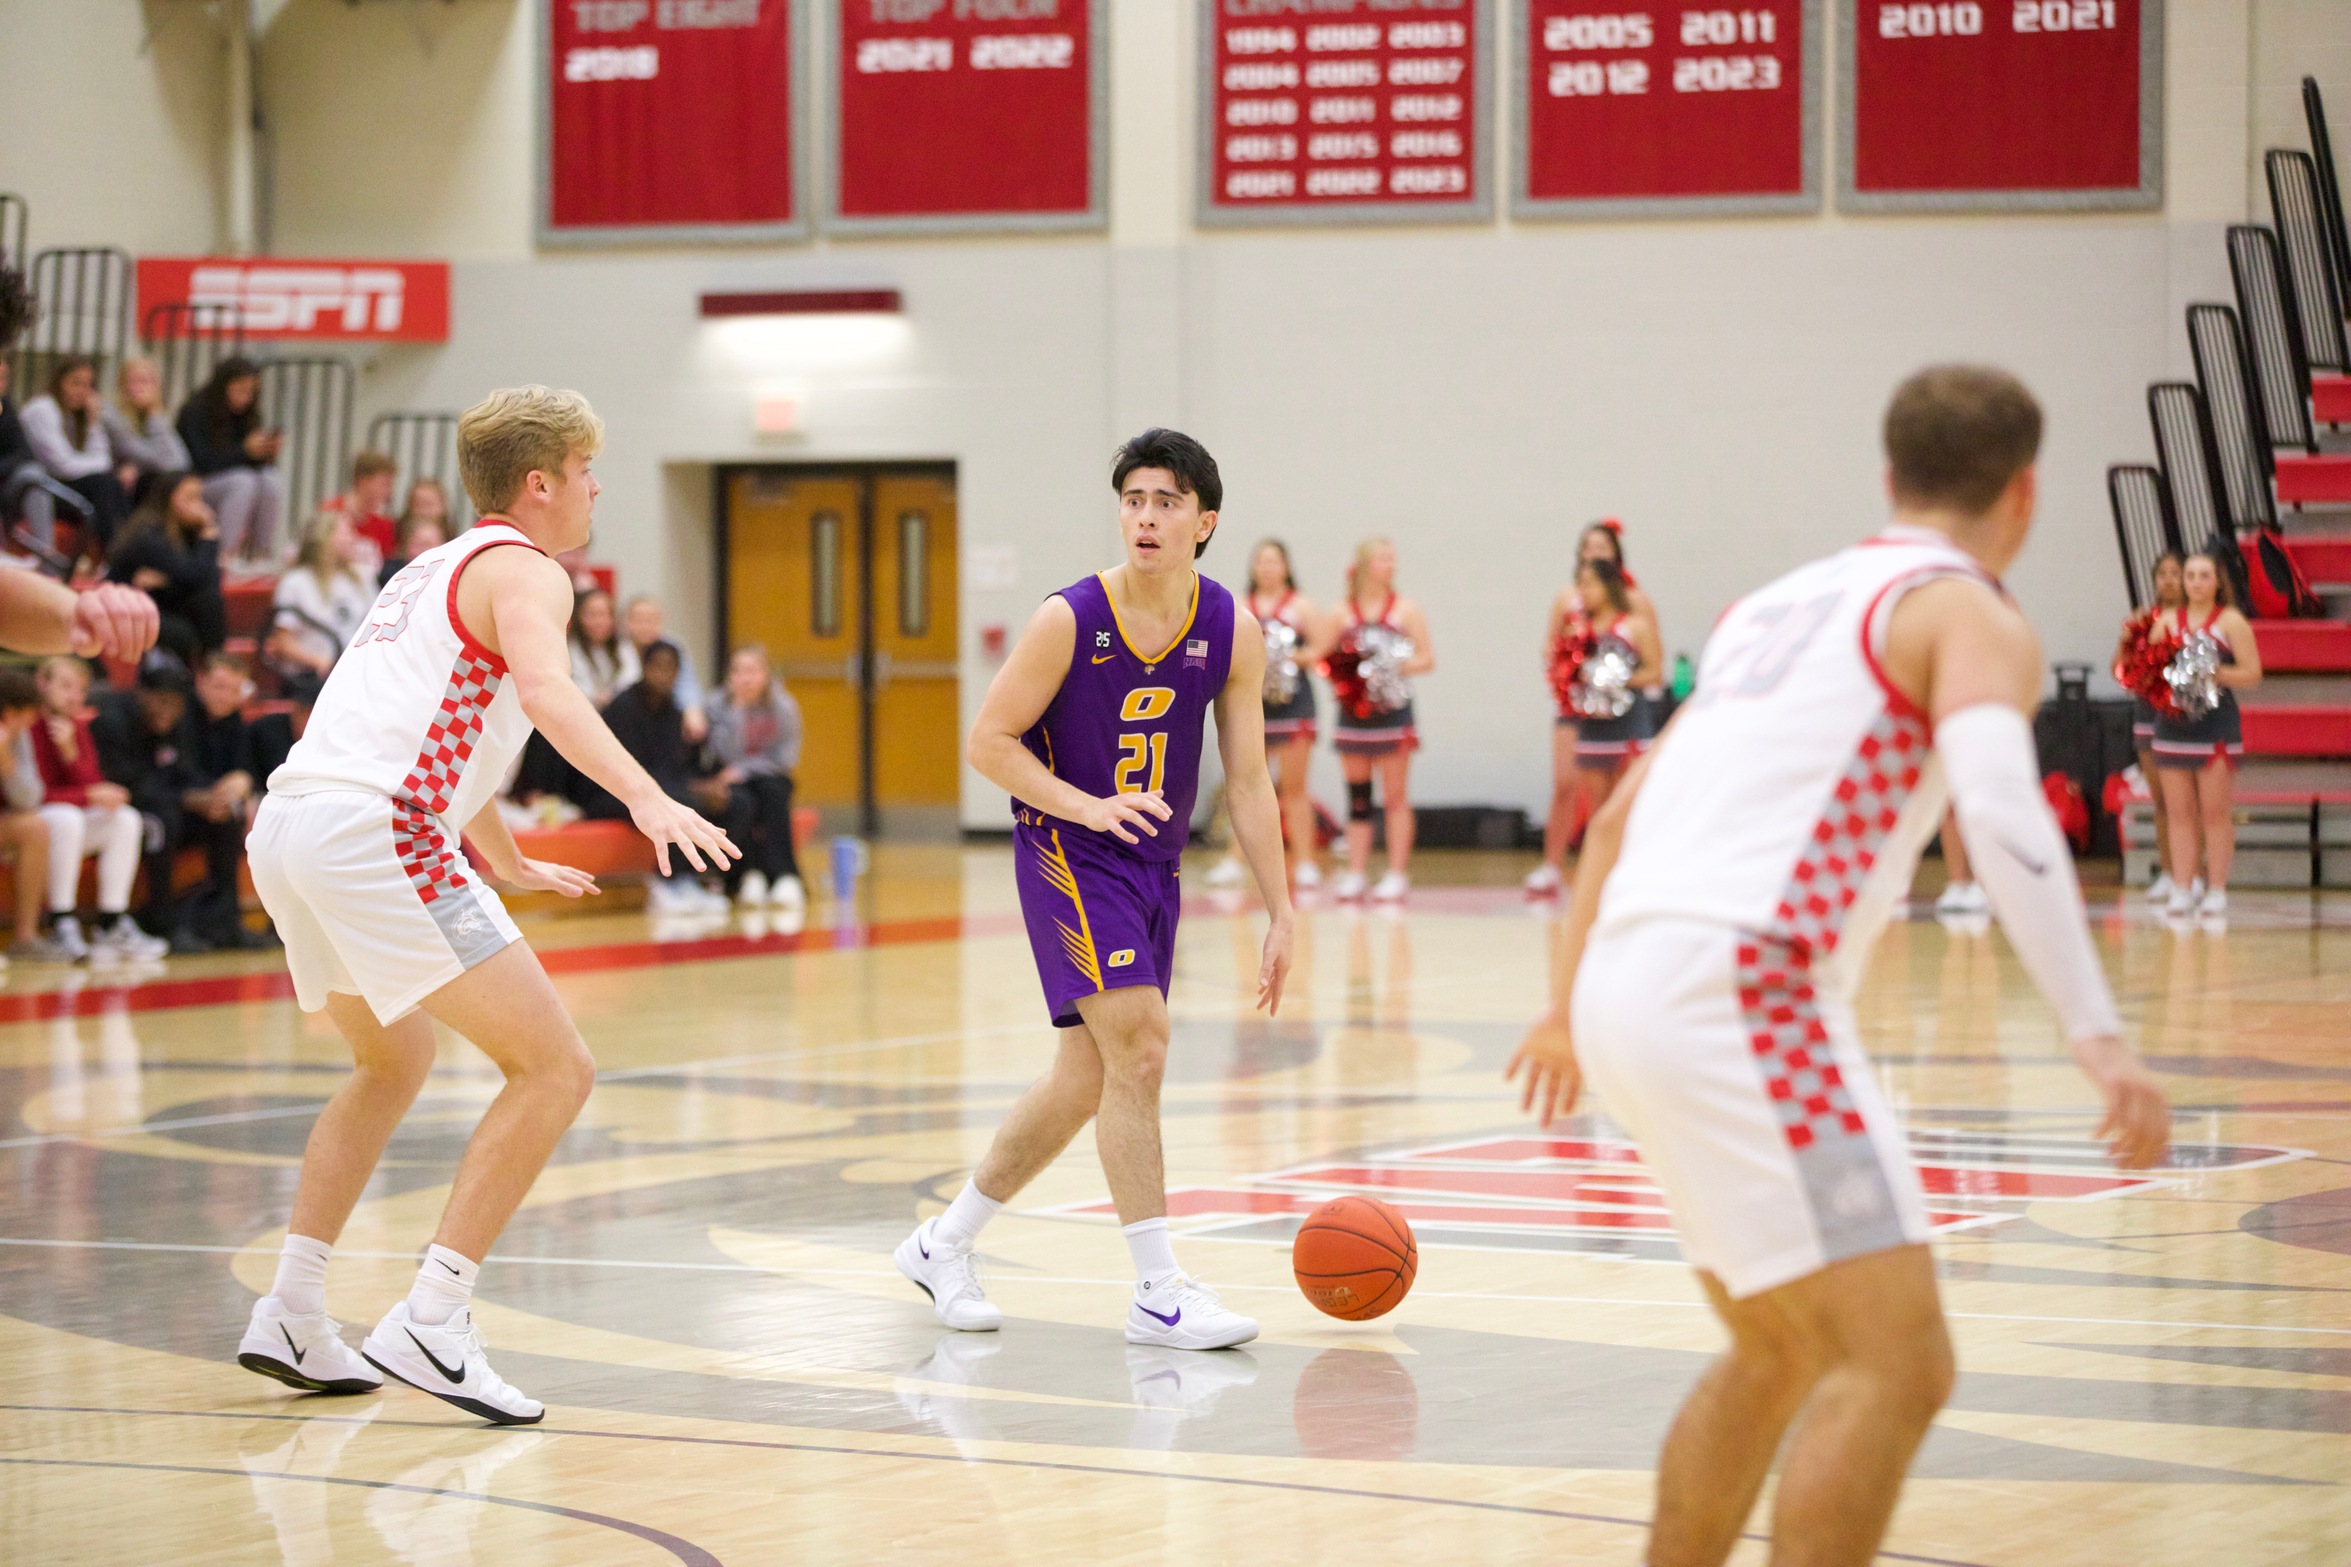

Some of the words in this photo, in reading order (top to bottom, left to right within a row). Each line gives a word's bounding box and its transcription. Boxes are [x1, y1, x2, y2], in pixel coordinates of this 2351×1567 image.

[570, 0, 649, 31] TOP
[1544, 13, 1653, 51] 2005
[1680, 10, 1776, 46] 2011
[1879, 2, 1982, 38] 2010
[2012, 0, 2115, 33] 2021
[856, 38, 953, 73] 2021
[970, 34, 1074, 70] 2022
[1388, 57, 1464, 85] 2007
[1548, 60, 1650, 97] 2012
[1672, 56, 1781, 93] 2023
[187, 267, 404, 332] ESPN
[354, 559, 446, 647] 23
[1095, 627, 1112, 648] 25
[1120, 687, 1176, 721] O
[1115, 732, 1168, 796] 21
[1108, 948, 1136, 968] O
